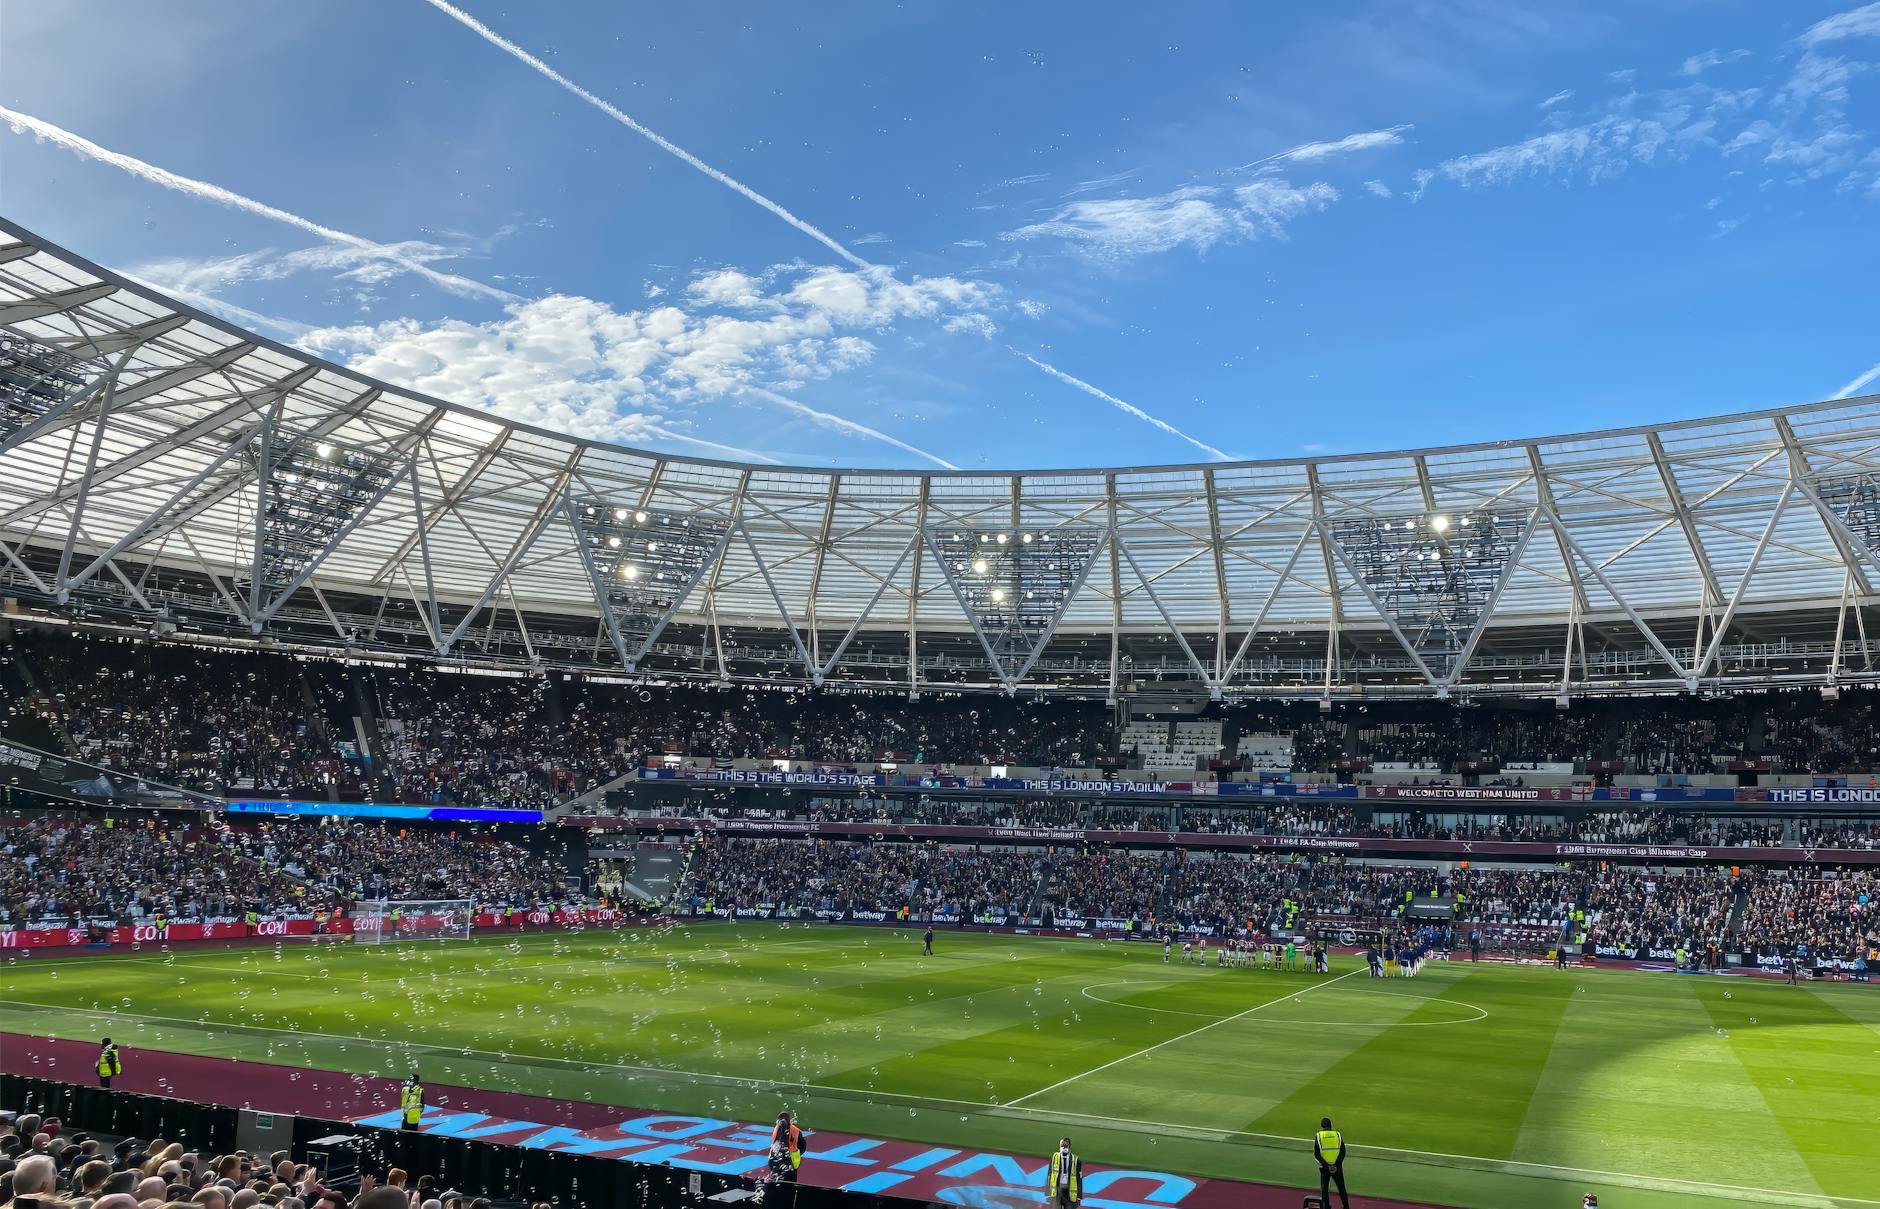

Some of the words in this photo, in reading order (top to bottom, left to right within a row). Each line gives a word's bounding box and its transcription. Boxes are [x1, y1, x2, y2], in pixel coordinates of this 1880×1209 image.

[718, 769, 744, 781] THIS
[747, 771, 758, 781] IS
[760, 772, 782, 782] THE
[785, 772, 837, 784] WORLD'S
[839, 774, 876, 785] STAGE
[1023, 780, 1048, 790] THIS
[1051, 780, 1061, 790] IS
[1064, 781, 1111, 792] LONDON
[1112, 781, 1167, 793] STADIUM
[1397, 789, 1443, 798] WELCOME
[1443, 790, 1454, 798] TO
[1505, 790, 1539, 799] UNITED
[1769, 789, 1807, 802] THIS
[1811, 790, 1825, 802] IS
[1586, 846, 1628, 856] European
[1688, 849, 1707, 858] Cup
[853, 910, 886, 921] betway
[257, 920, 288, 936] COYI
[1053, 918, 1088, 929] betway
[0, 931, 17, 947] YI
[619, 1114, 1197, 1204] UNITED
